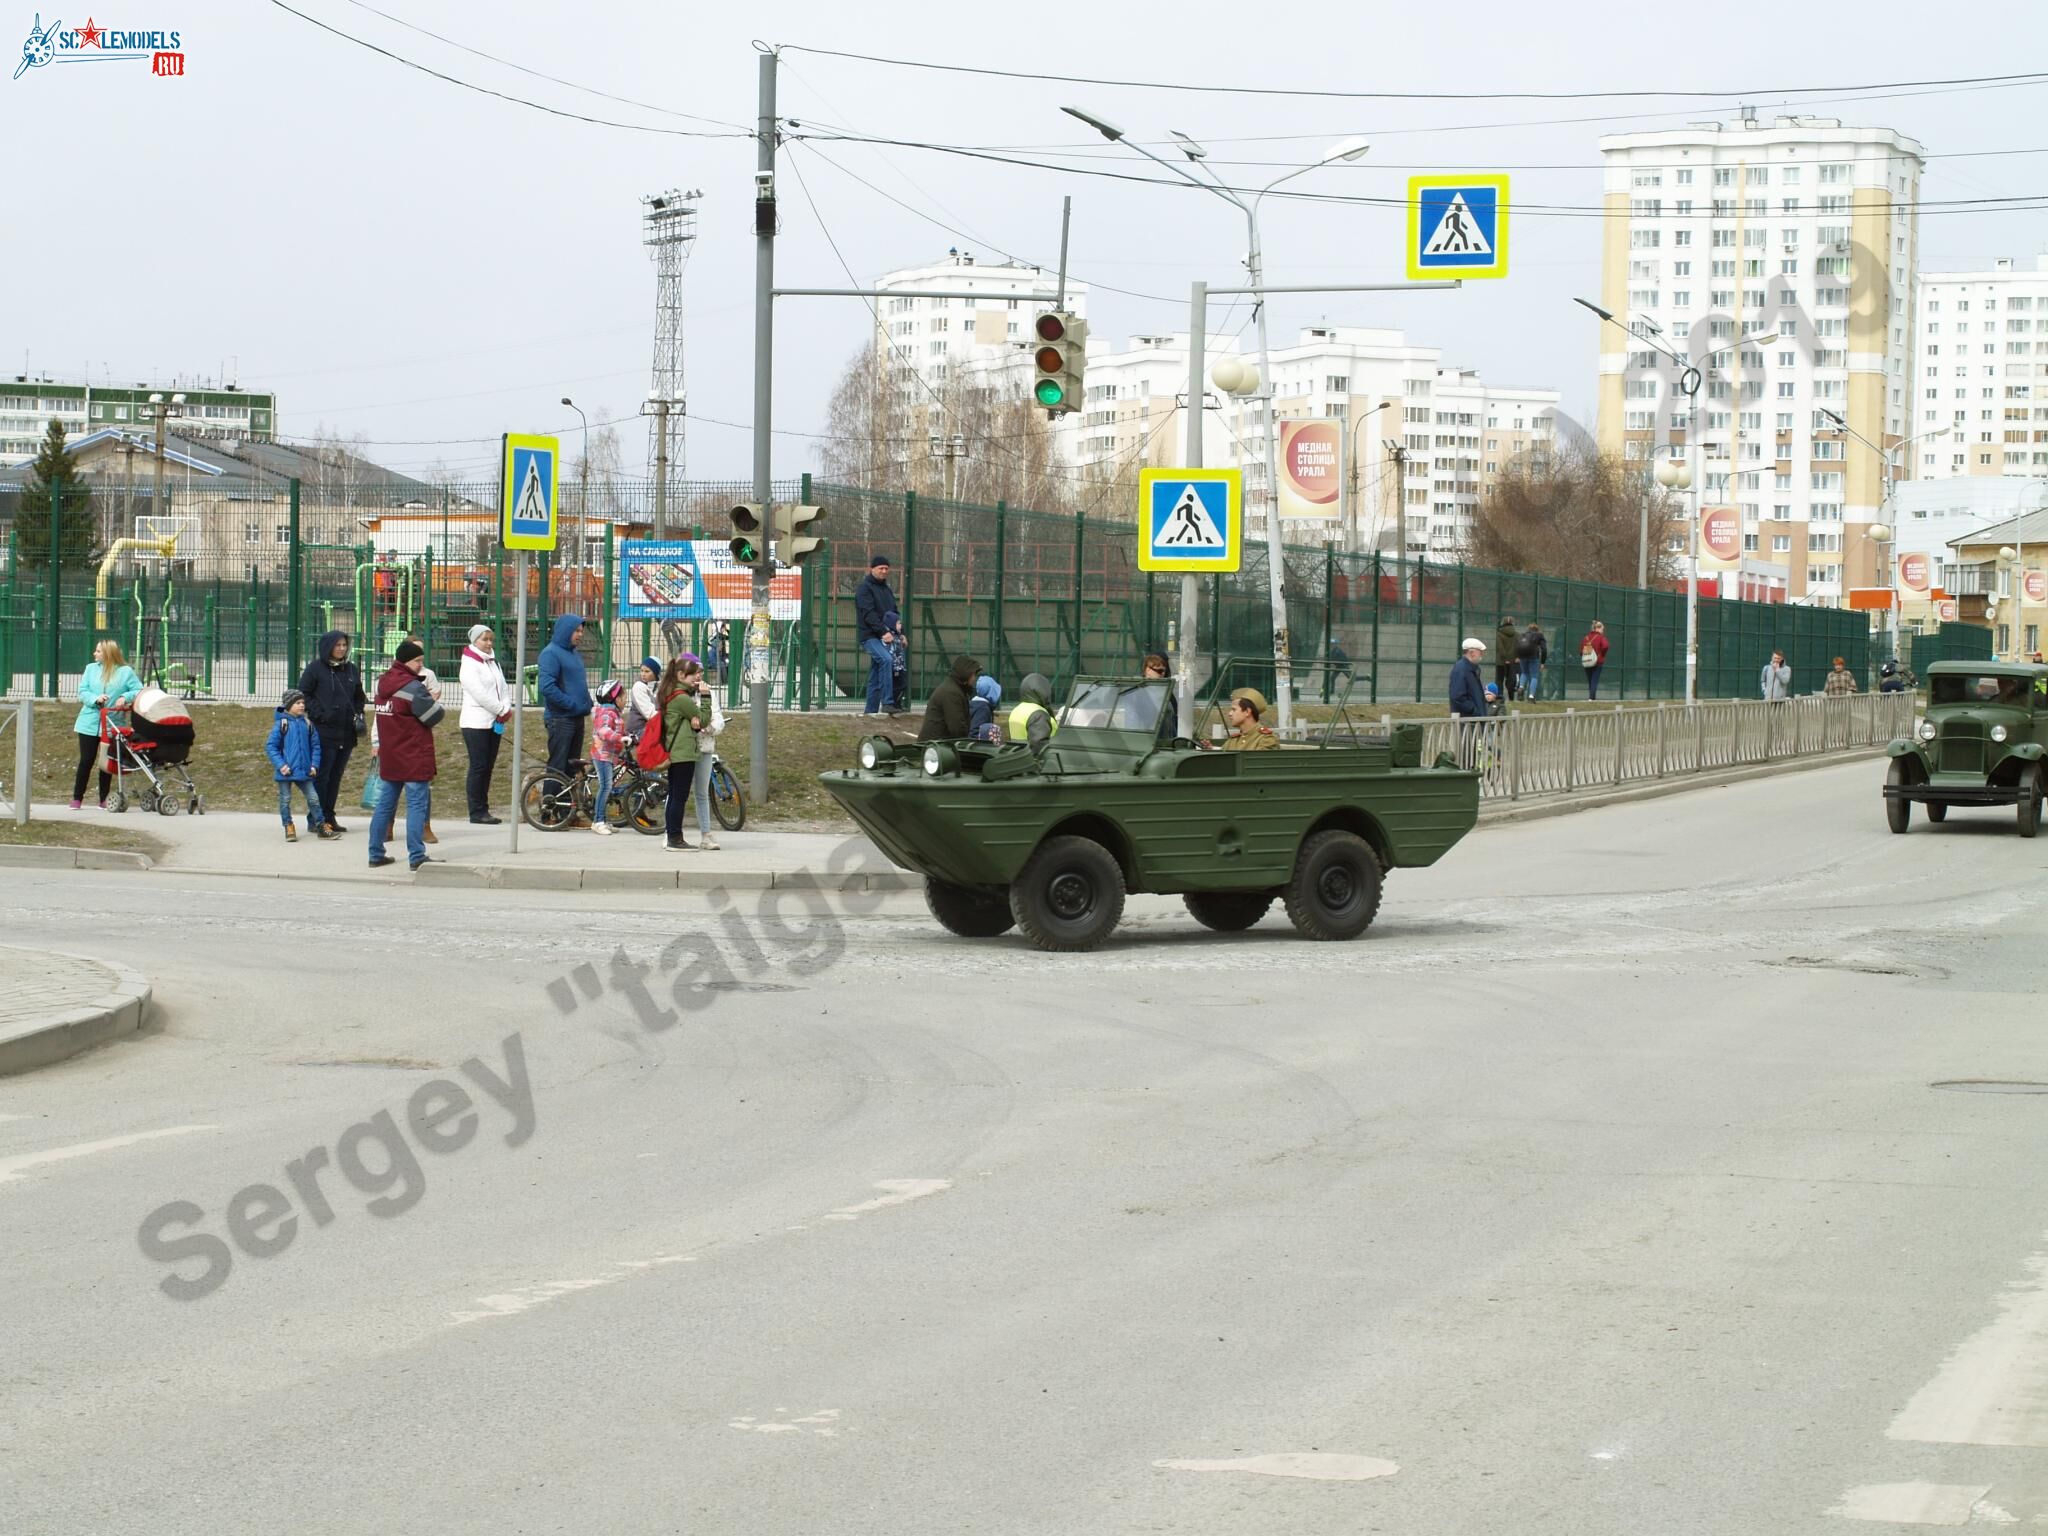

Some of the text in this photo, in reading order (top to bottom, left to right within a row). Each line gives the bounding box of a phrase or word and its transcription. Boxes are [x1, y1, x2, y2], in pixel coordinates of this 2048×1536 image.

[1297, 442, 1332, 453] МЕДНАЯ
[1297, 454, 1336, 466] СТОЛИЦА
[1297, 466, 1326, 477] УРАЛА
